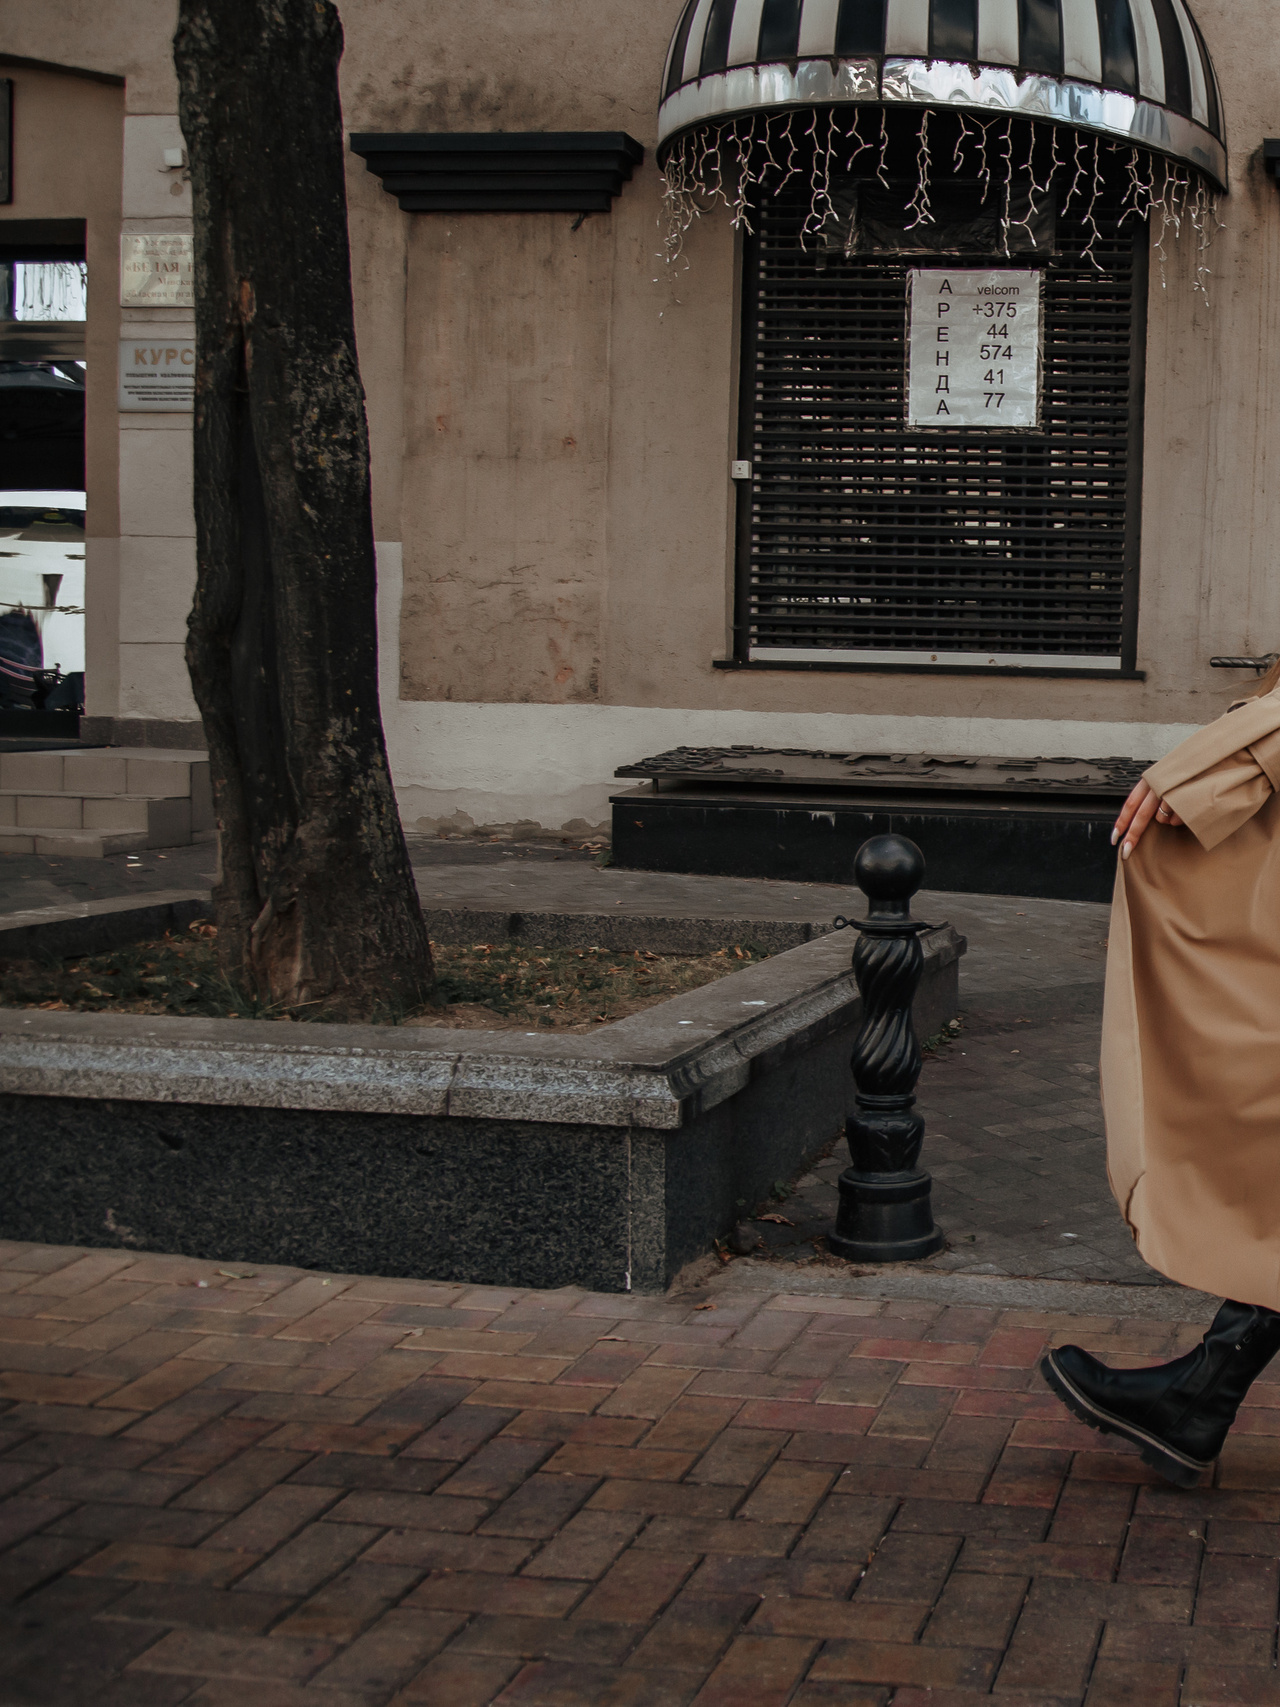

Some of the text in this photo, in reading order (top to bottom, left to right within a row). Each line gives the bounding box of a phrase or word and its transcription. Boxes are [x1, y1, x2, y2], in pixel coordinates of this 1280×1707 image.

[977, 284, 1020, 296] velcom
[972, 301, 1018, 319] +375
[986, 323, 1009, 339] 44
[935, 278, 953, 415] АРЕНДА
[979, 345, 1014, 360] 574
[983, 368, 1004, 385] 41
[983, 392, 1006, 408] 77
